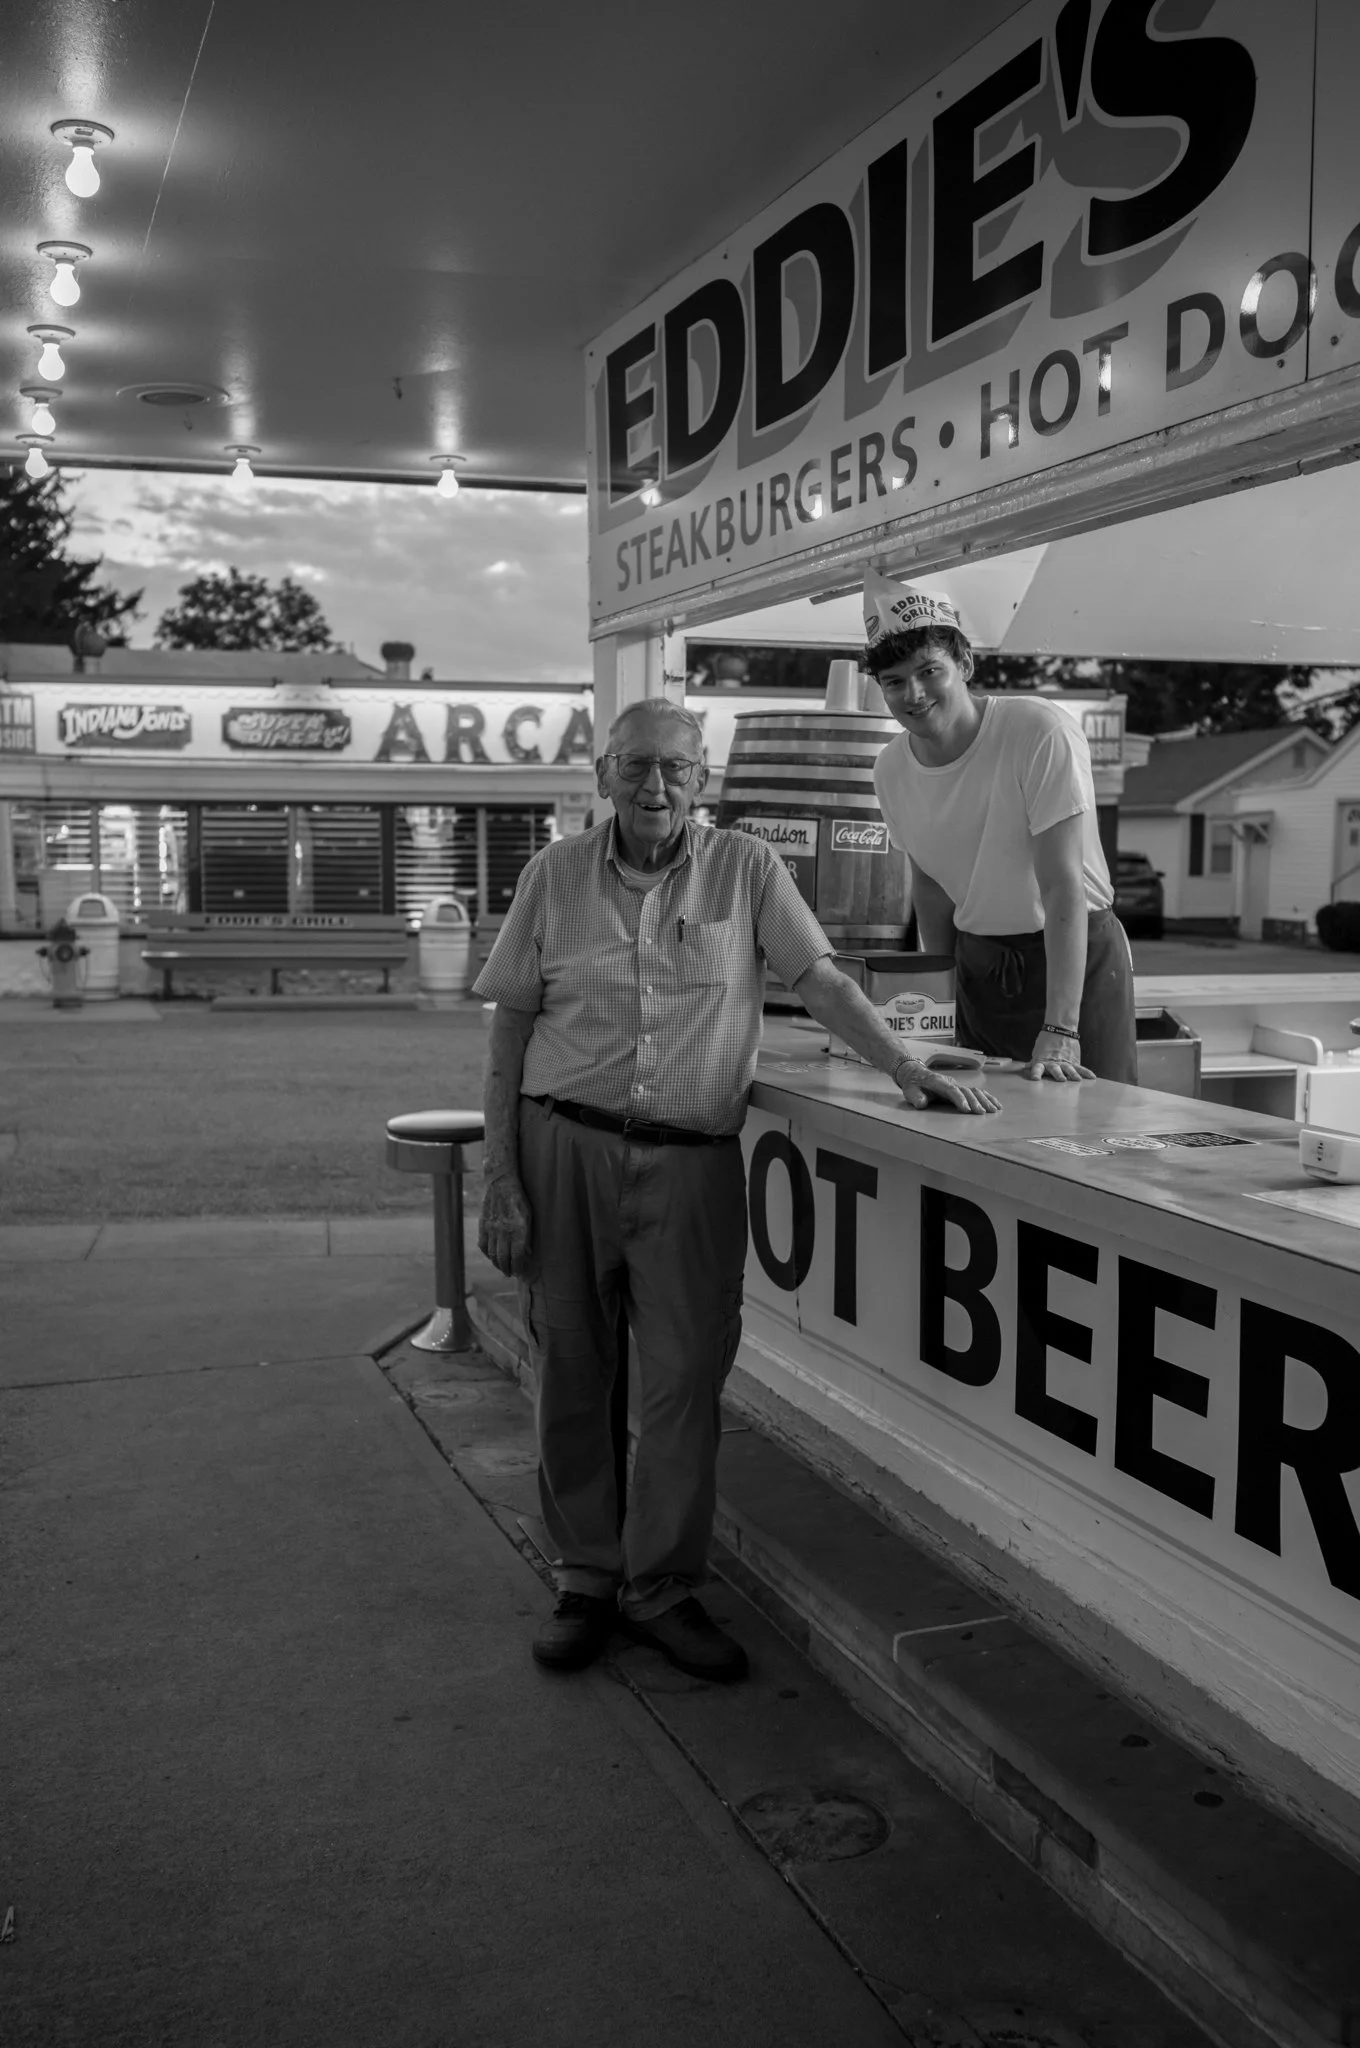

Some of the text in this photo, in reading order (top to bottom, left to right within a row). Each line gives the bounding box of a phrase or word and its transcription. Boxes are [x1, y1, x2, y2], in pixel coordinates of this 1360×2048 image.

[607, 0, 1257, 505] EDDIE'S
[616, 416, 918, 591] STEAKBURGERS
[980, 321, 1129, 460] HOT
[890, 595, 936, 615] EDDIE'S
[901, 607, 937, 623] GRILL
[0, 698, 32, 724] TM
[62, 705, 189, 744] INDIANA JONES
[373, 703, 593, 763] ARCA
[1084, 714, 1120, 739] ATM
[0, 728, 33, 749] SIDE
[919, 1016, 954, 1029] GRILL
[919, 1182, 1360, 1603] BEER
